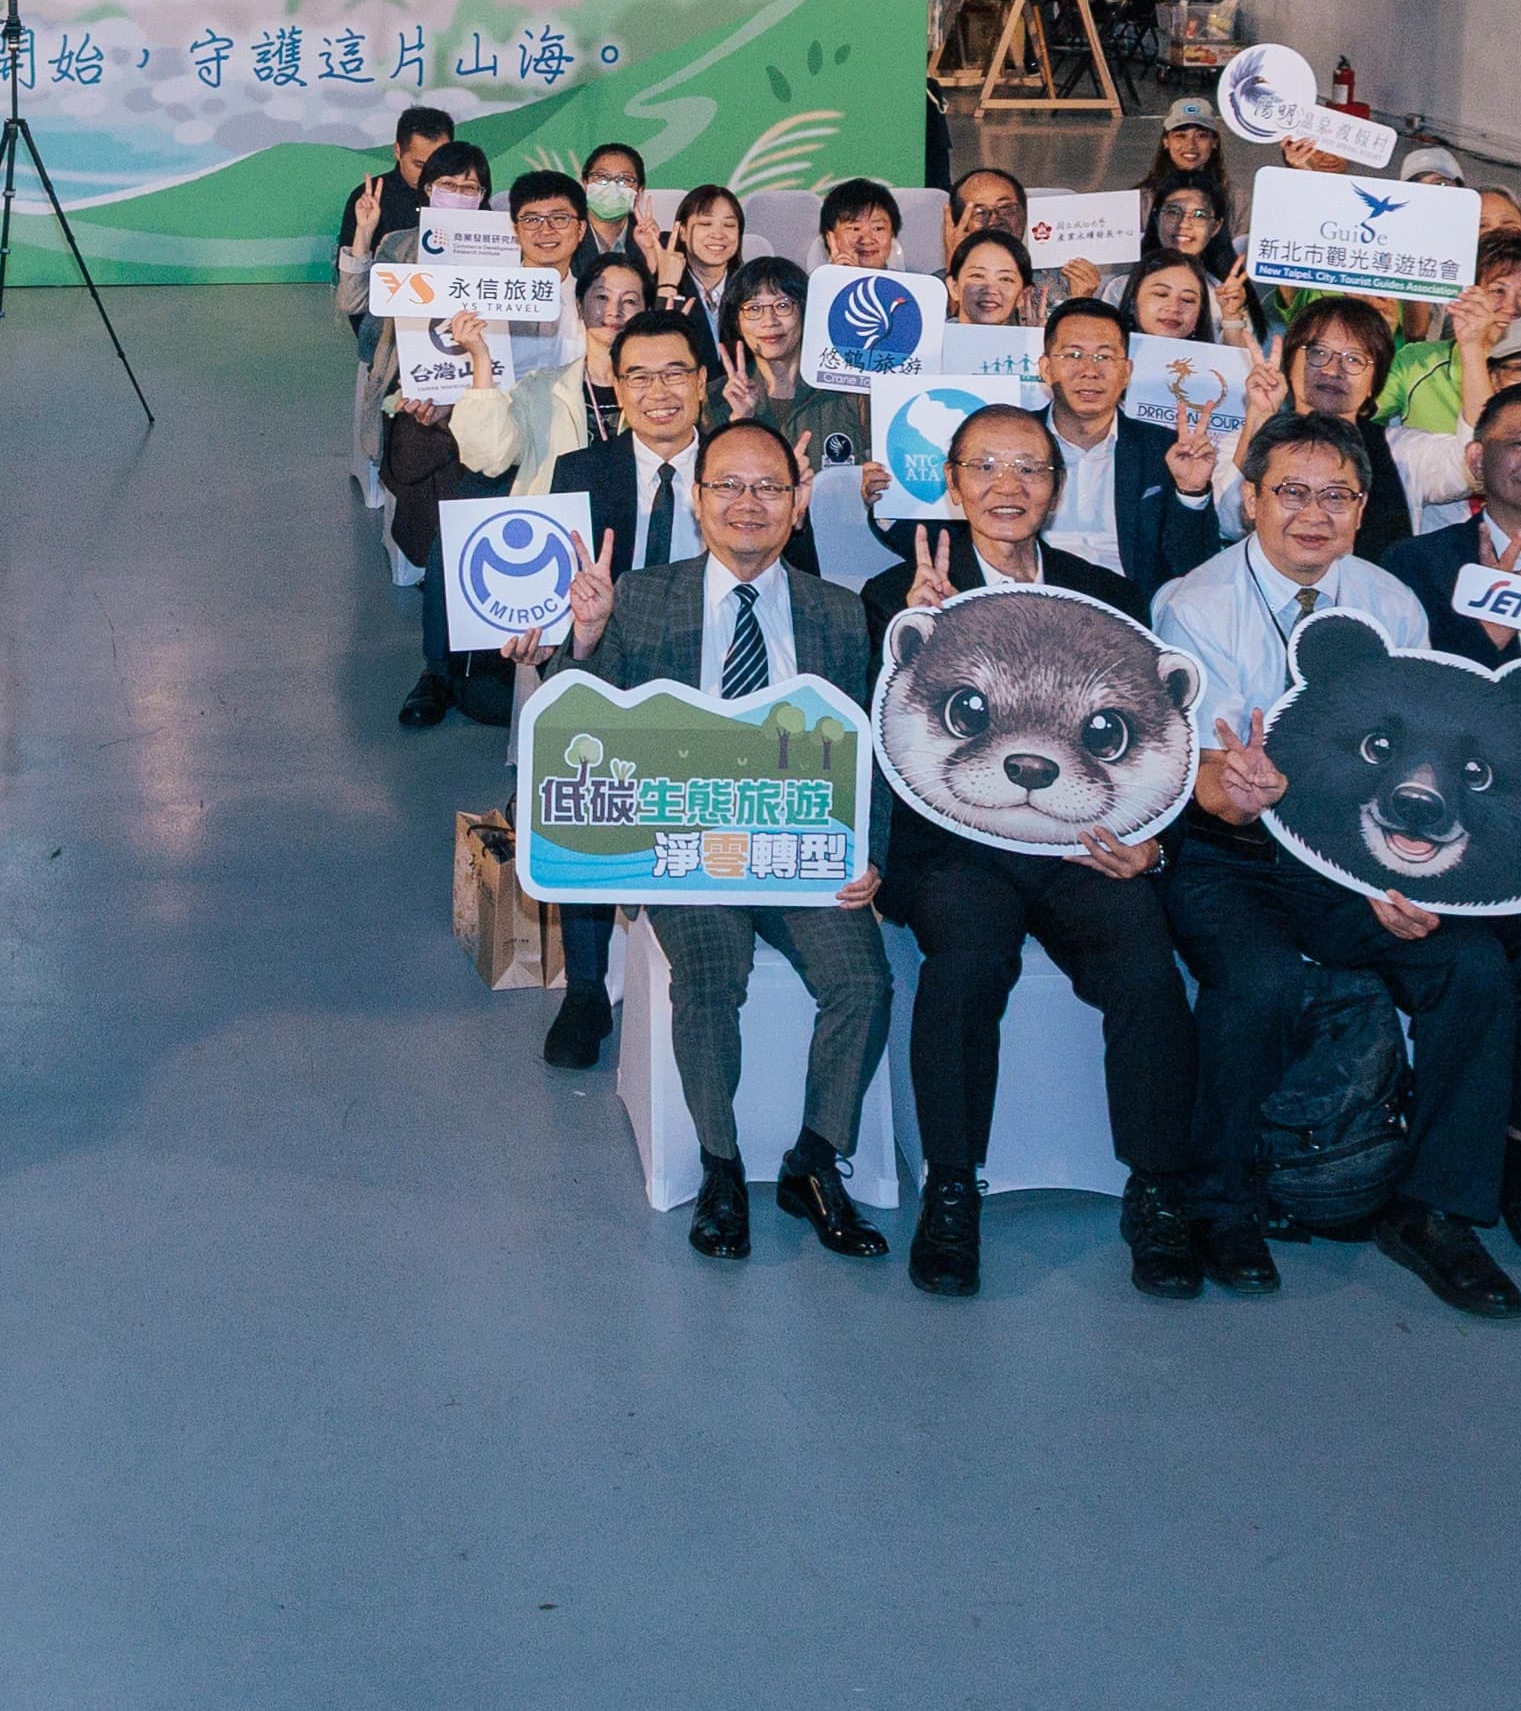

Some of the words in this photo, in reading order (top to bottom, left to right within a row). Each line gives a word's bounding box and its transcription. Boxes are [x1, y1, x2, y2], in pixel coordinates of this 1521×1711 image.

[1257, 237, 1461, 281] 新北市觀光導遊協會
[448, 277, 554, 302] 永信旅遊
[1259, 265, 1282, 277] New
[1340, 274, 1373, 288] Tourist
[1373, 277, 1405, 292] Guides
[1406, 281, 1462, 297] Association
[462, 302, 478, 311] YS
[487, 303, 540, 313] TRAVEL
[823, 372, 857, 386] Crane
[1137, 404, 1199, 425] DRAGN
[904, 453, 939, 468] NTC
[905, 468, 942, 482] ATA
[489, 597, 559, 624] MIRDC
[539, 776, 834, 827] 低碳生態旅遊
[652, 831, 848, 880] 淨零轉型
